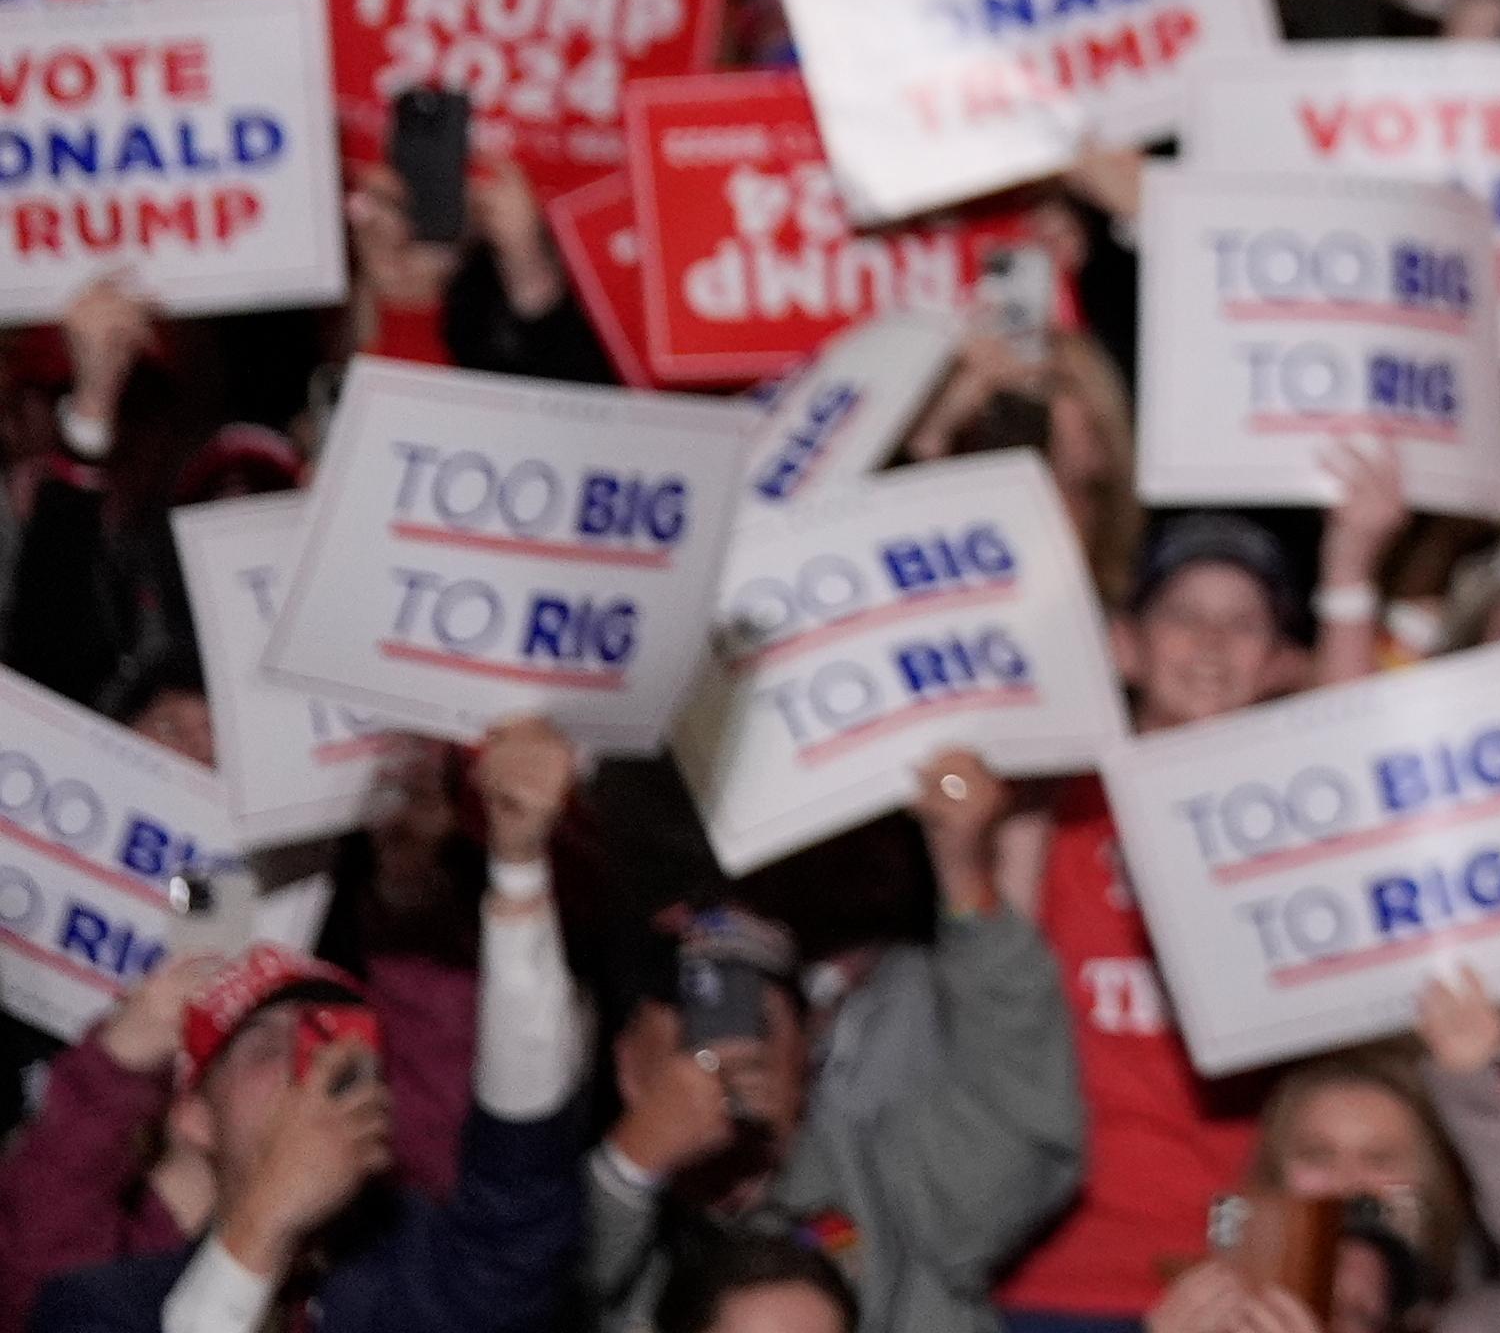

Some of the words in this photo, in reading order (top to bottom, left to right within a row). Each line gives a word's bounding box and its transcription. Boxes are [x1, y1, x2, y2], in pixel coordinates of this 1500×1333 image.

[0, 41, 212, 109] VOTE
[376, 23, 627, 123] 2024
[0, 109, 286, 187] ONALD
[6, 187, 264, 257] RUMP
[680, 231, 962, 321] RUMP
[1212, 231, 1378, 307] TOO
[1390, 241, 1474, 309] BIG
[1250, 341, 1350, 407] TO
[1366, 355, 1460, 415] RIG
[390, 439, 561, 531] TOO
[574, 467, 690, 545] BIG
[388, 567, 502, 653] TO
[520, 589, 641, 667] RIG
[730, 551, 868, 633] OO
[878, 523, 1018, 595] BIG
[755, 659, 880, 745] TO
[892, 627, 1032, 697] RIG
[0, 749, 105, 841] OO
[1172, 763, 1356, 861] TOO
[1232, 883, 1350, 967] TO
